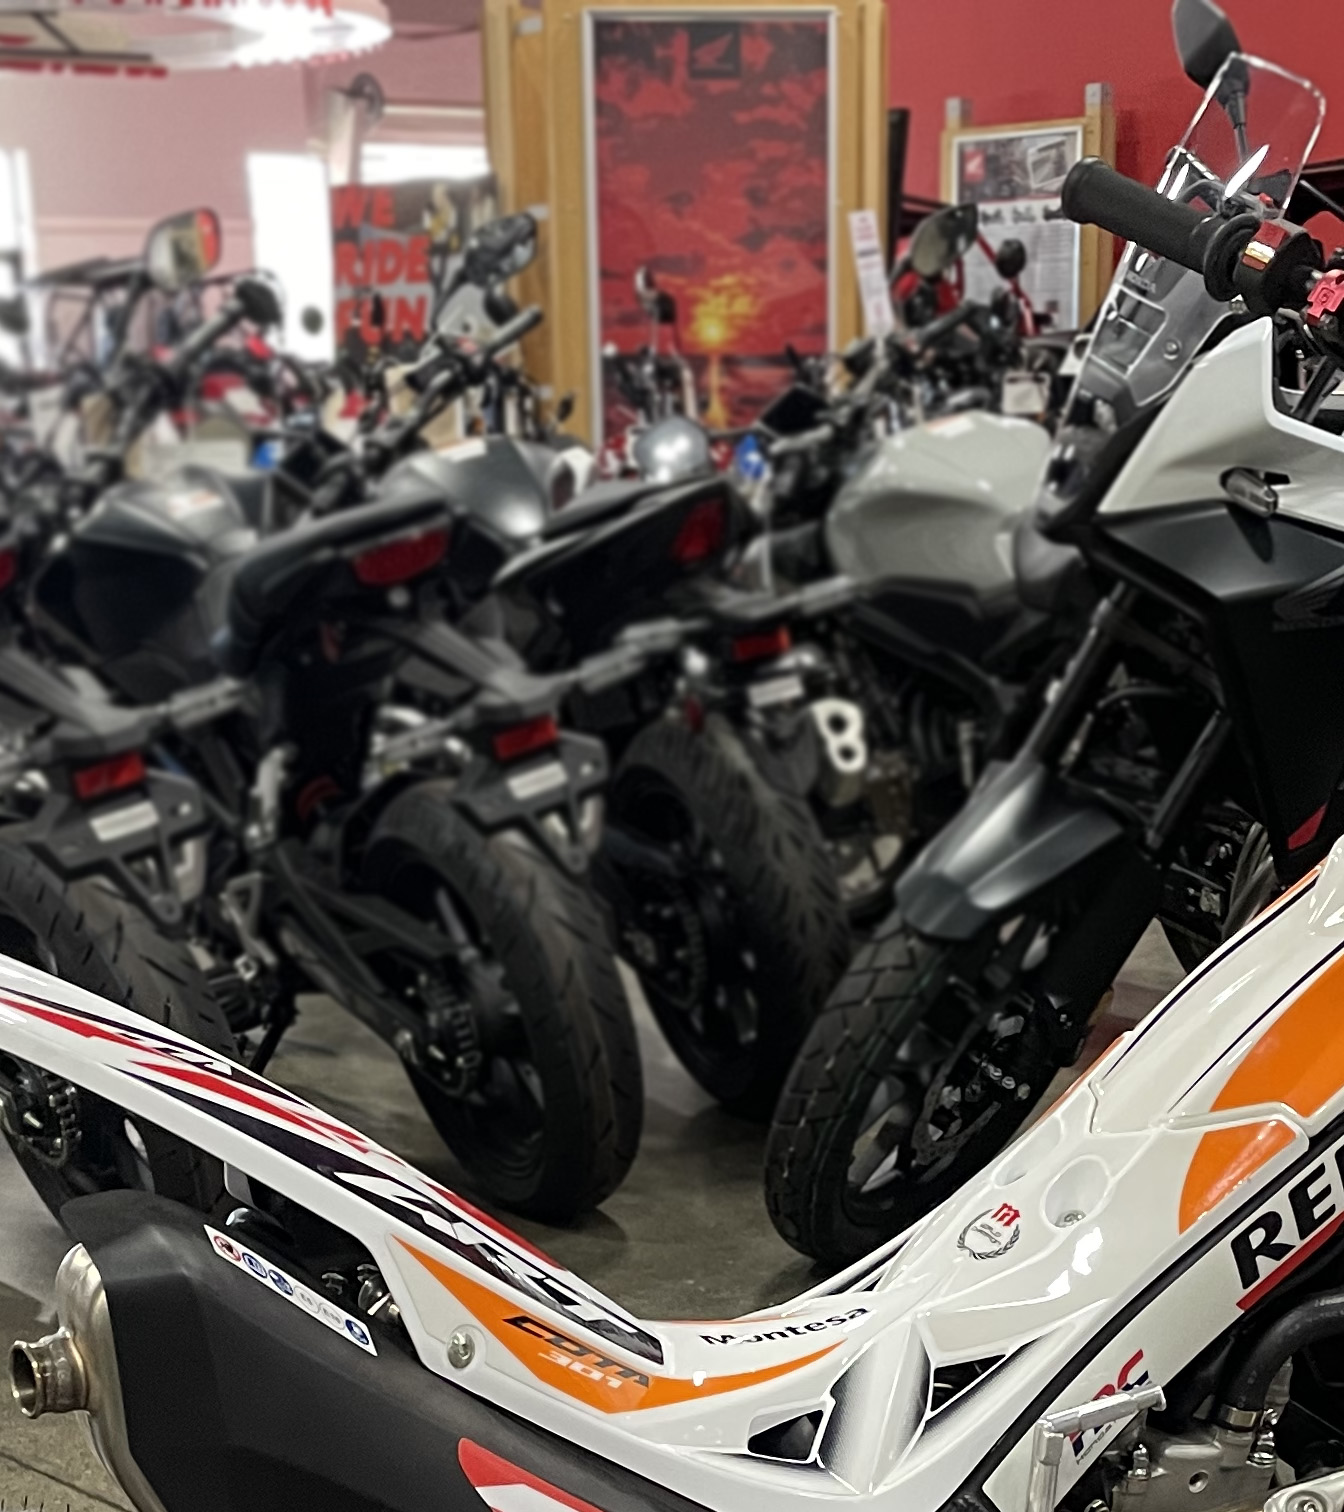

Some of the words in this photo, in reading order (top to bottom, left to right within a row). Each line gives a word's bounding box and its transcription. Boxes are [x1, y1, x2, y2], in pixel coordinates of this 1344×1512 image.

[330, 184, 396, 230] WE
[335, 234, 432, 289] RIDE
[335, 293, 428, 345] FUN
[537, 1350, 623, 1390] 301
